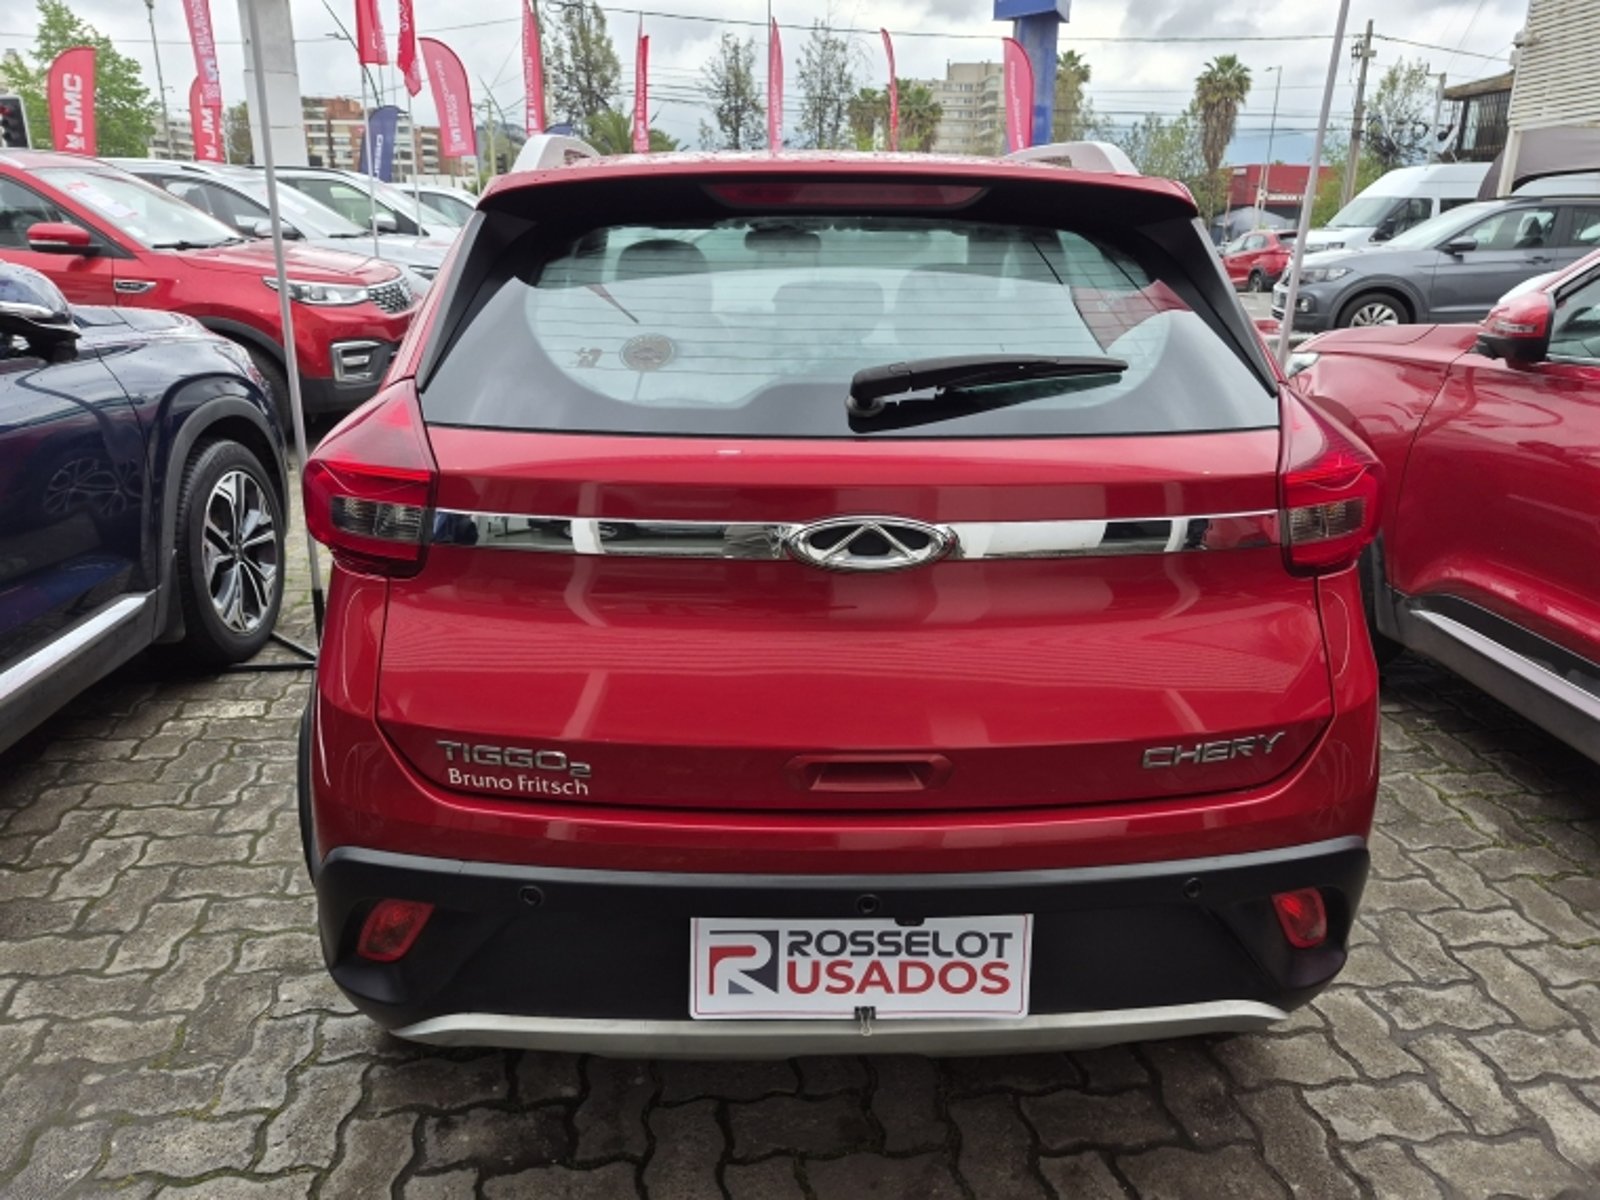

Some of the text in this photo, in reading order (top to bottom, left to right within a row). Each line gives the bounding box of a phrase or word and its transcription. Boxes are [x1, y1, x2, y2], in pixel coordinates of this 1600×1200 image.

[62, 73, 83, 134] JMC
[1143, 731, 1285, 768] CHERY
[448, 768, 588, 796] Bruno Fritsch
[787, 930, 1013, 958] ROSSELOT
[787, 960, 1010, 995] USADOS
